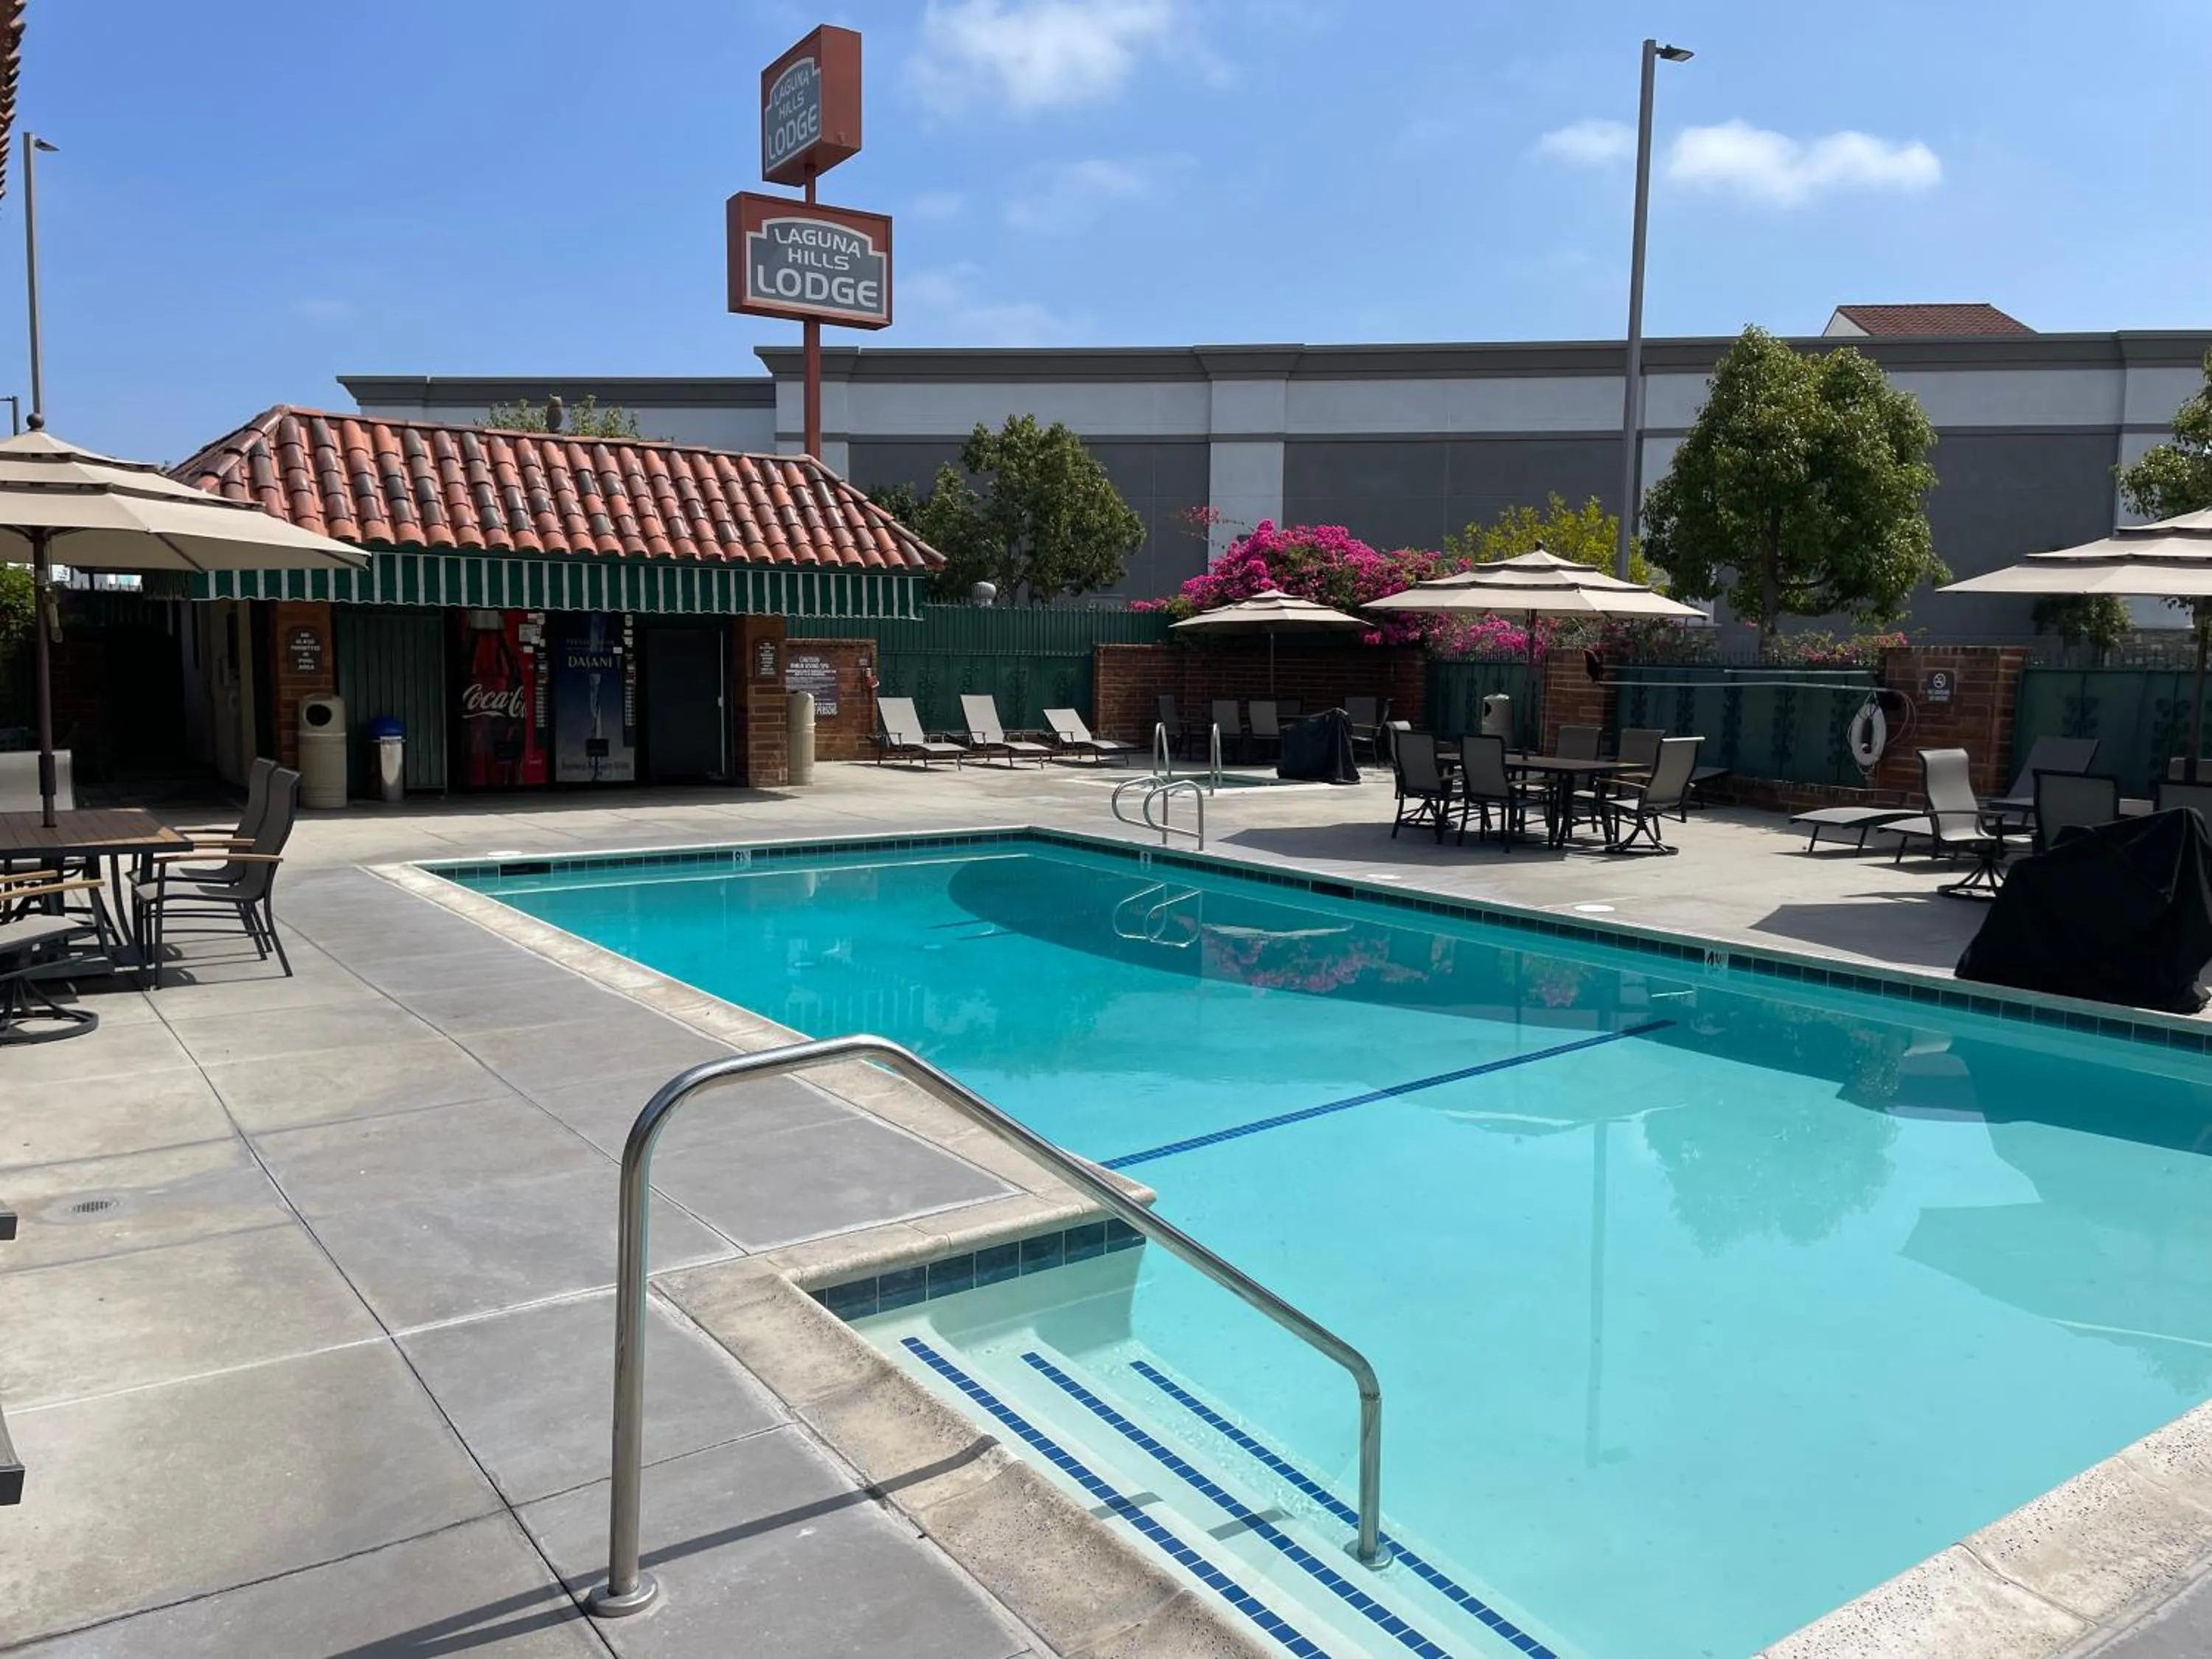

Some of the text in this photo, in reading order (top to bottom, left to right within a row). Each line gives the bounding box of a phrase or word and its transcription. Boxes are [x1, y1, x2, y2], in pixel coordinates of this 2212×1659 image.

[773, 71, 810, 105] LAGUNA
[779, 91, 804, 119] HILLS
[768, 104, 818, 159] LODGE
[775, 228, 860, 257] LAGUNA
[788, 248, 849, 271] HILLS
[757, 265, 877, 307] LODGE
[568, 655, 613, 668] DASANI
